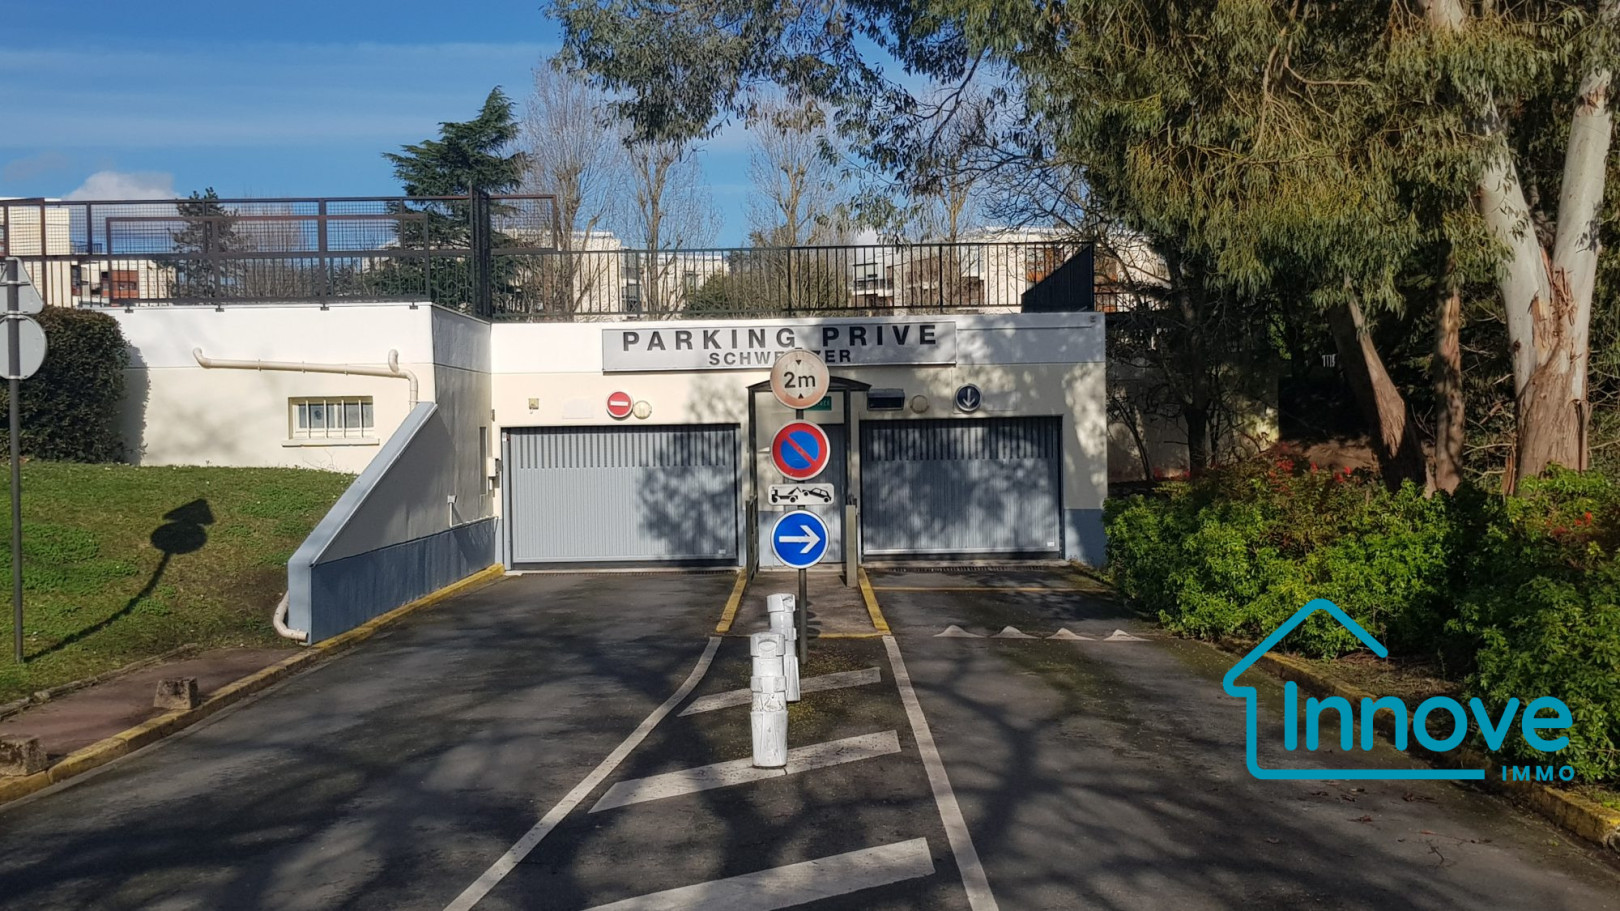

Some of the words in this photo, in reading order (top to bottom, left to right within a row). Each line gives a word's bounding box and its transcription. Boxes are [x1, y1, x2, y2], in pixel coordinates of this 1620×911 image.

[622, 328, 796, 352] PARKING
[822, 325, 936, 347] PRIVE
[709, 350, 851, 366] SCHWEER
[783, 371, 816, 389] 2m
